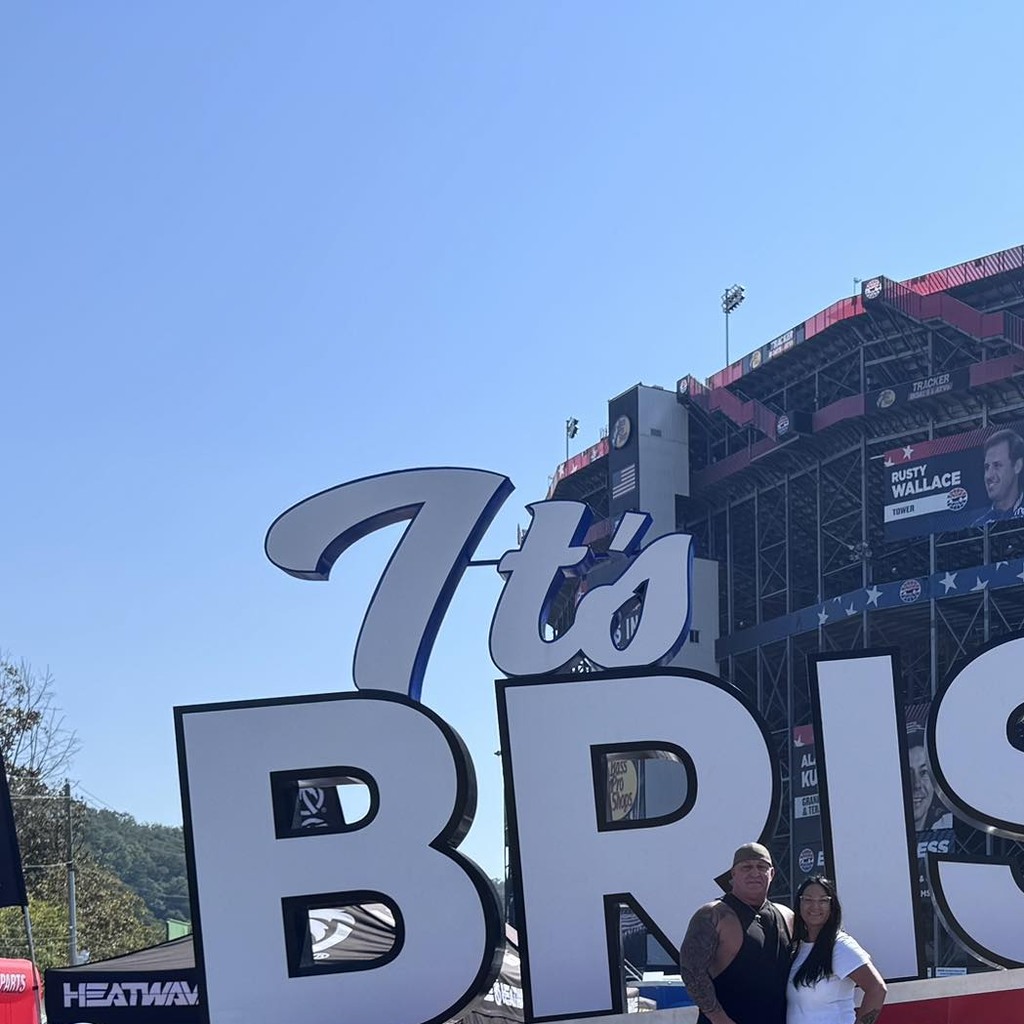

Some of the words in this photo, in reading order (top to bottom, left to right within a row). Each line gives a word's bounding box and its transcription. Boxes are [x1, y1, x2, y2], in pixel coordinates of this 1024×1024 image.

[891, 464, 927, 483] RUSTY
[891, 470, 961, 498] WALLACE
[892, 504, 915, 516] TOWER
[264, 466, 695, 702] It's
[801, 754, 816, 769] AL
[0, 973, 27, 993] PARTS
[63, 981, 199, 1008] HEATWAV
